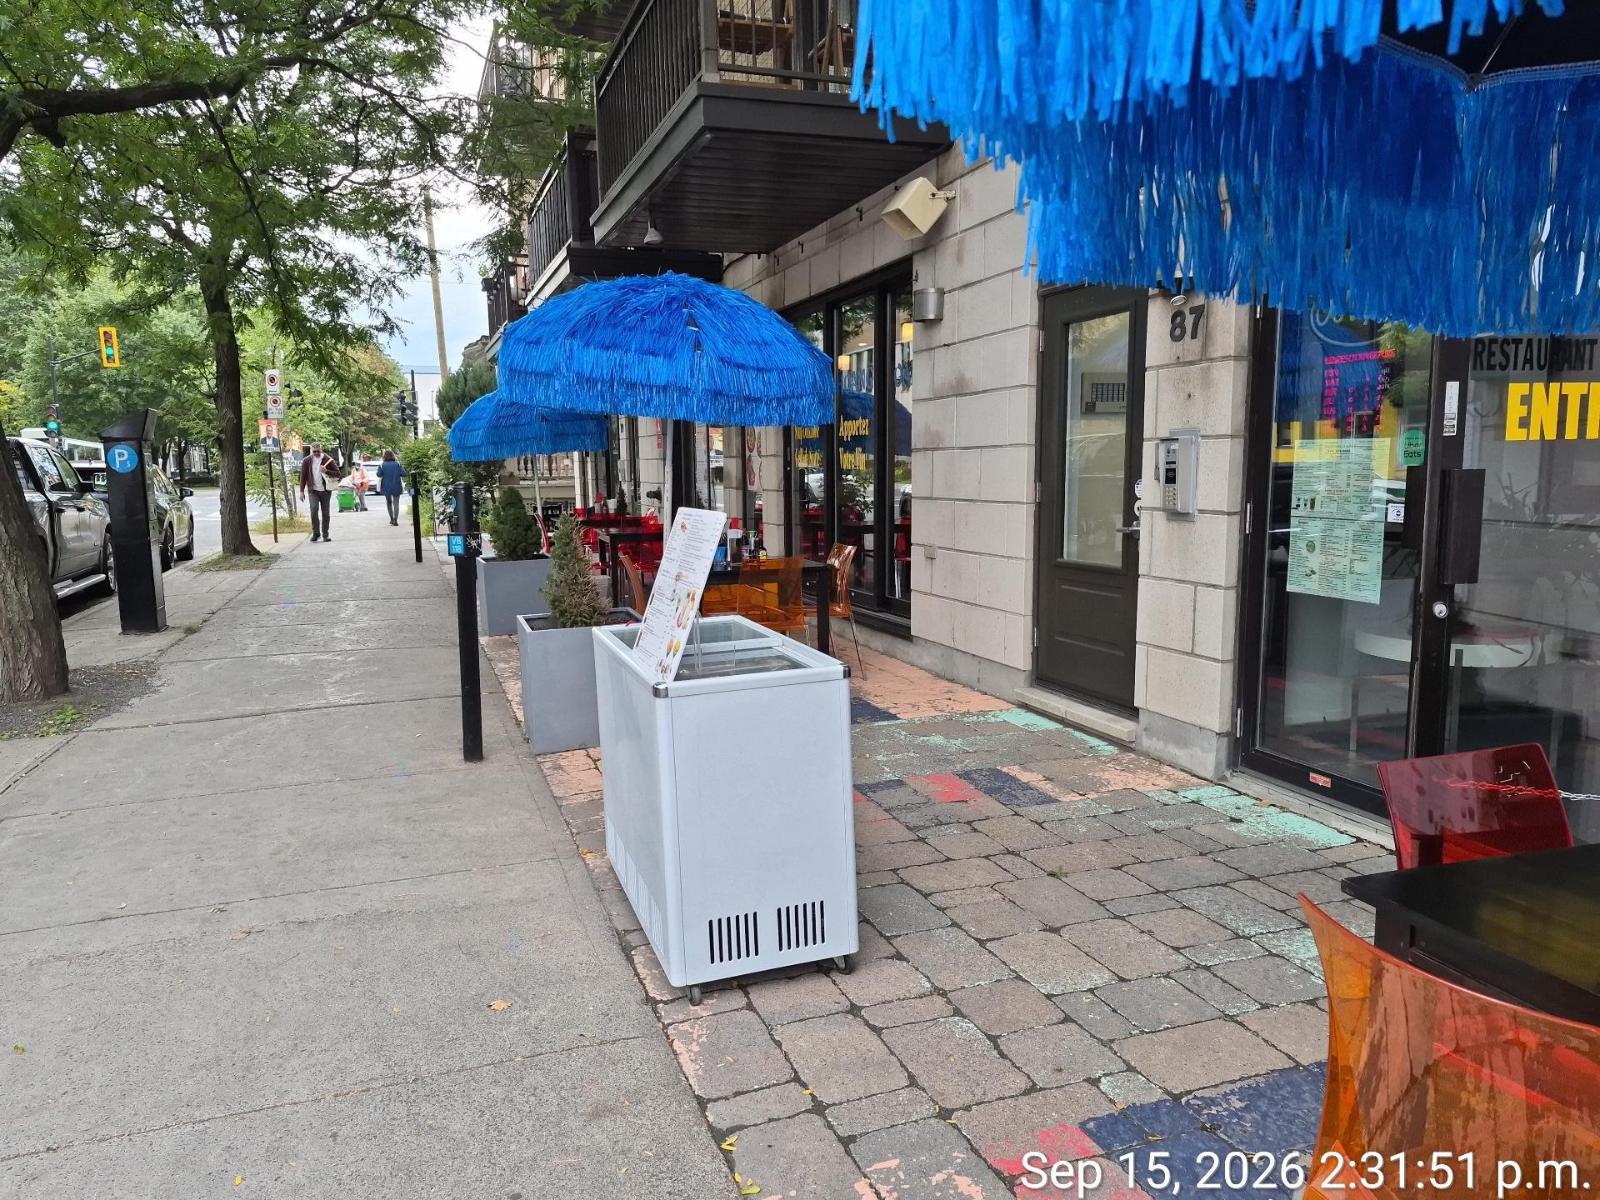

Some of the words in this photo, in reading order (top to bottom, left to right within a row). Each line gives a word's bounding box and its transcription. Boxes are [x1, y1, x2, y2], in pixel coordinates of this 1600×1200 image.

[1170, 304, 1205, 342] 87
[1473, 338, 1598, 371] RESTAURANT
[839, 415, 869, 442] Apportez
[1404, 450, 1422, 458] Eats
